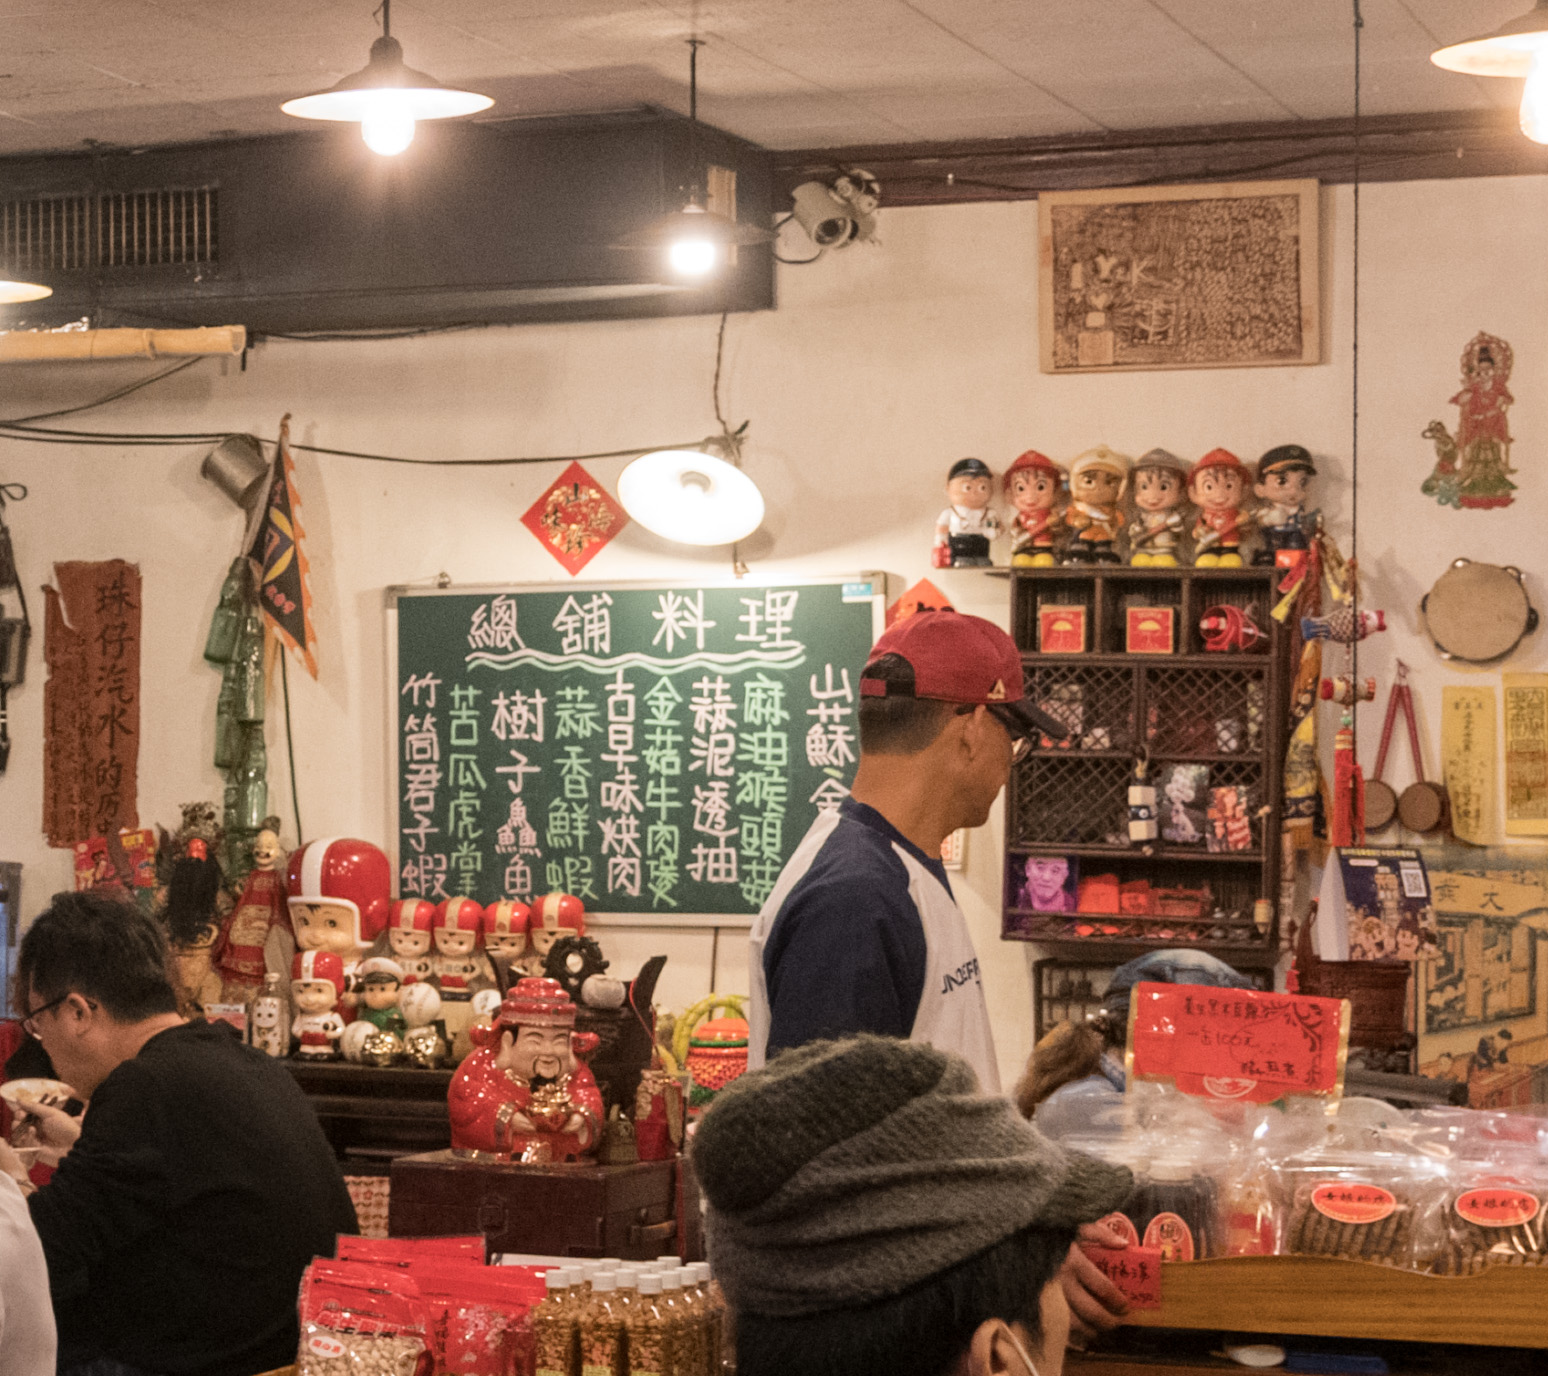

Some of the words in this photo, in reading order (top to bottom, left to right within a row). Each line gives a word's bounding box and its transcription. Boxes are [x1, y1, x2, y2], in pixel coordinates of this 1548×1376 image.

[401, 671, 451, 899] 竹筒君子蝦
[545, 685, 604, 901] 蒜香鮮蝦
[597, 668, 644, 897] 古早味烘肉
[685, 675, 740, 884] 蒜泥透抽
